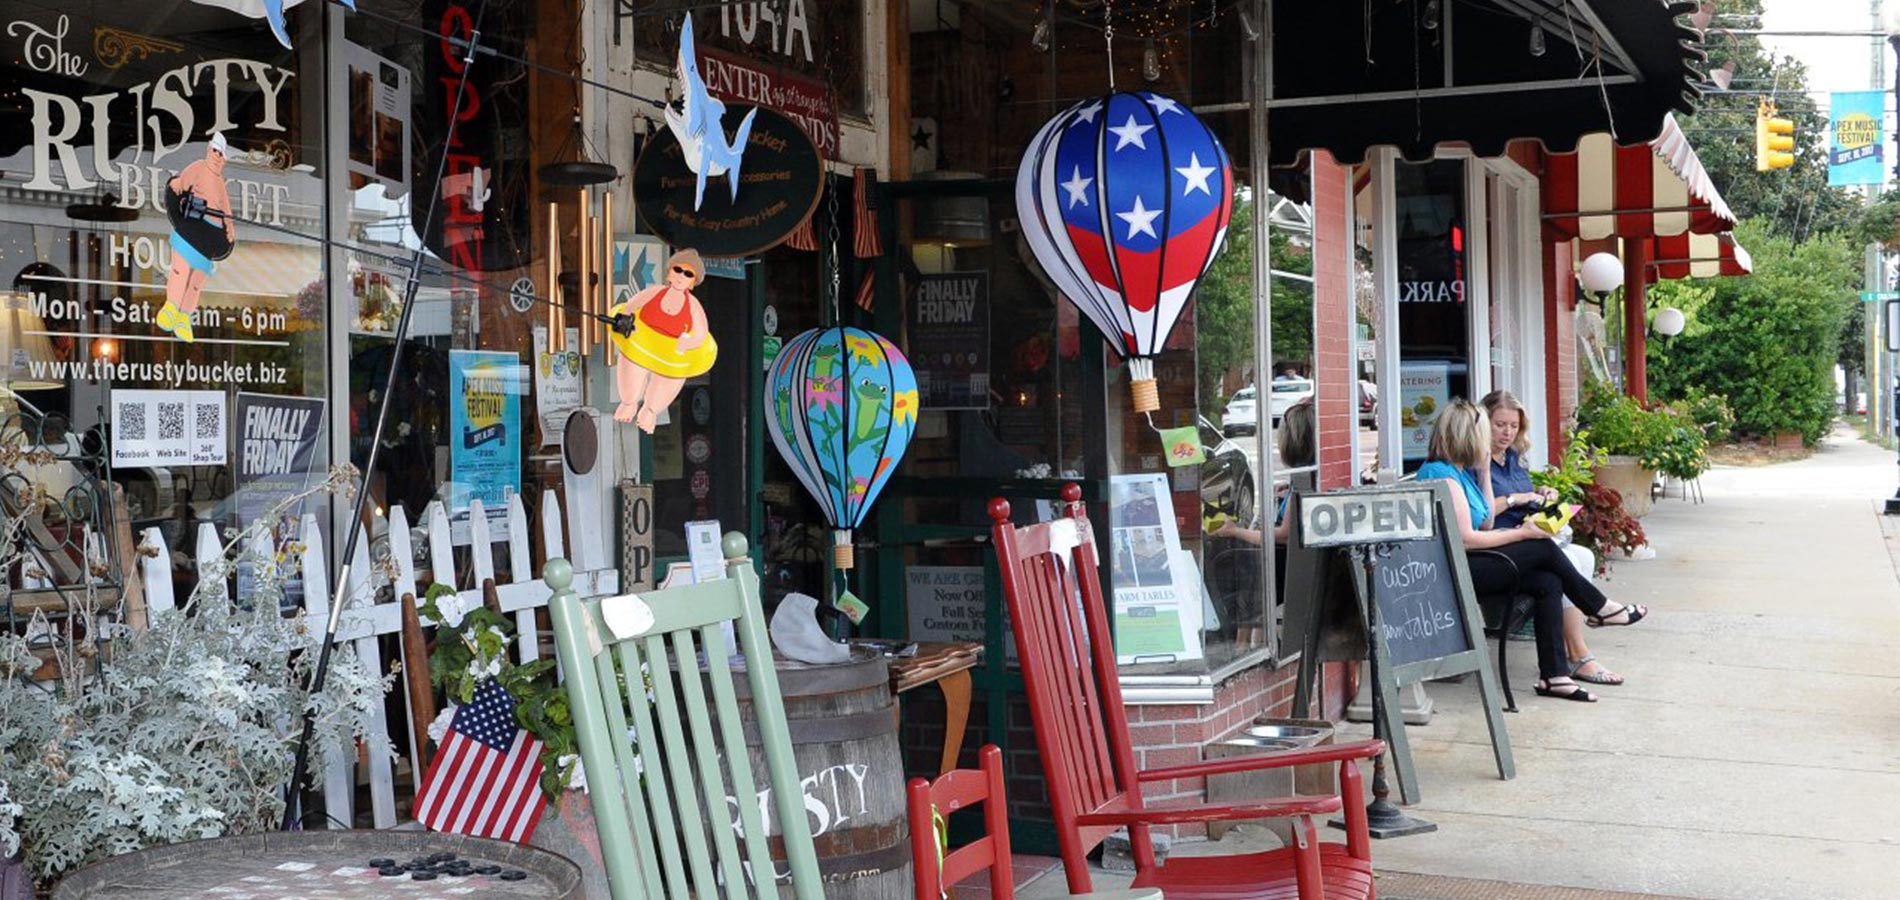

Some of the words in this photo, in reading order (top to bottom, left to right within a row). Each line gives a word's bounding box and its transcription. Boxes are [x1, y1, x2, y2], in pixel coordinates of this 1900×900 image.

[7, 14, 89, 77] The
[704, 56, 773, 106] ENTER
[21, 58, 296, 190] RUSTY
[1830, 120, 1851, 132] APEX
[1855, 119, 1883, 131] MUSIC
[749, 130, 789, 155] ucket
[1837, 132, 1875, 144] FESTIVAL
[439, 6, 493, 297] OPEN
[115, 162, 290, 227] BUET
[109, 235, 173, 272] HOU
[918, 278, 978, 301] FINALLY
[28, 291, 87, 321] Mon.
[112, 297, 156, 324] Sat.
[257, 312, 286, 335] pm
[917, 301, 975, 323] FRIDAY
[28, 357, 287, 387] www.therustybucket.biz
[1400, 376, 1442, 385] ATERING
[467, 398, 502, 418] FESTIVAL
[244, 405, 311, 440] FINALLY
[115, 449, 150, 459] Facebook
[156, 449, 172, 458] Web
[174, 449, 187, 458] Site
[193, 453, 209, 462] Shop
[243, 440, 299, 475] FRIDAY
[1310, 498, 1426, 537] OPEN
[632, 498, 651, 584] OP
[933, 572, 961, 585] ARE
[934, 589, 961, 601] Now
[1118, 591, 1141, 602] ARM
